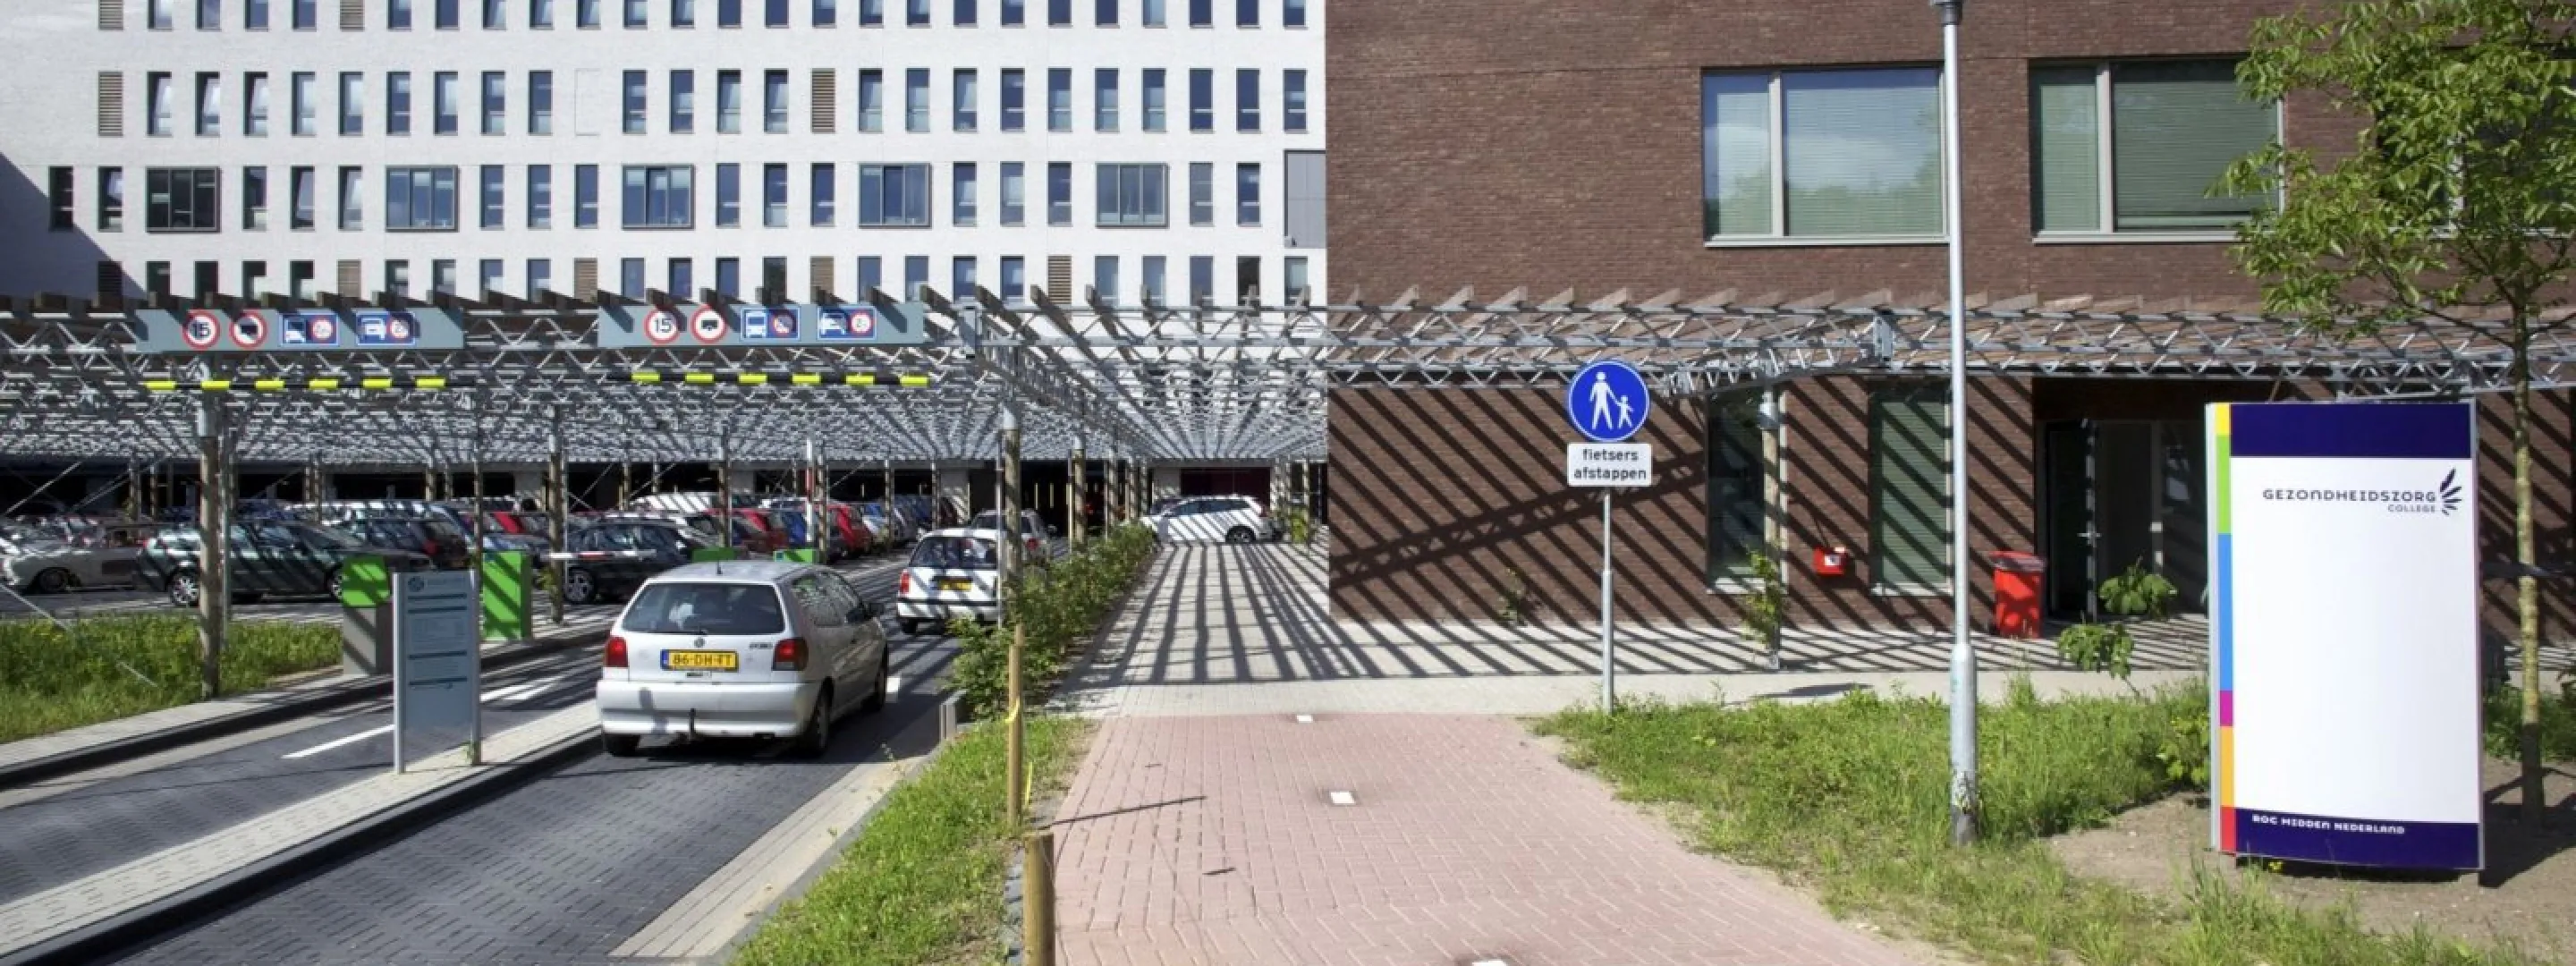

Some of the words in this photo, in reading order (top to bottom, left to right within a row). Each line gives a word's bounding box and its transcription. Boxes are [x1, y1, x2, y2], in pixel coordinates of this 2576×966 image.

[192, 323, 212, 338] 15
[654, 318, 672, 333] 15
[1582, 448, 1639, 462] fietsers
[1574, 467, 1647, 481] afstappen
[2262, 488, 2436, 503] GEZONDHEIDSZORG
[2387, 504, 2436, 513] COLLEGE
[2251, 813, 2278, 826] ROC
[2281, 817, 2331, 830] MIDDEN
[2334, 822, 2405, 835] NEDERLAND
